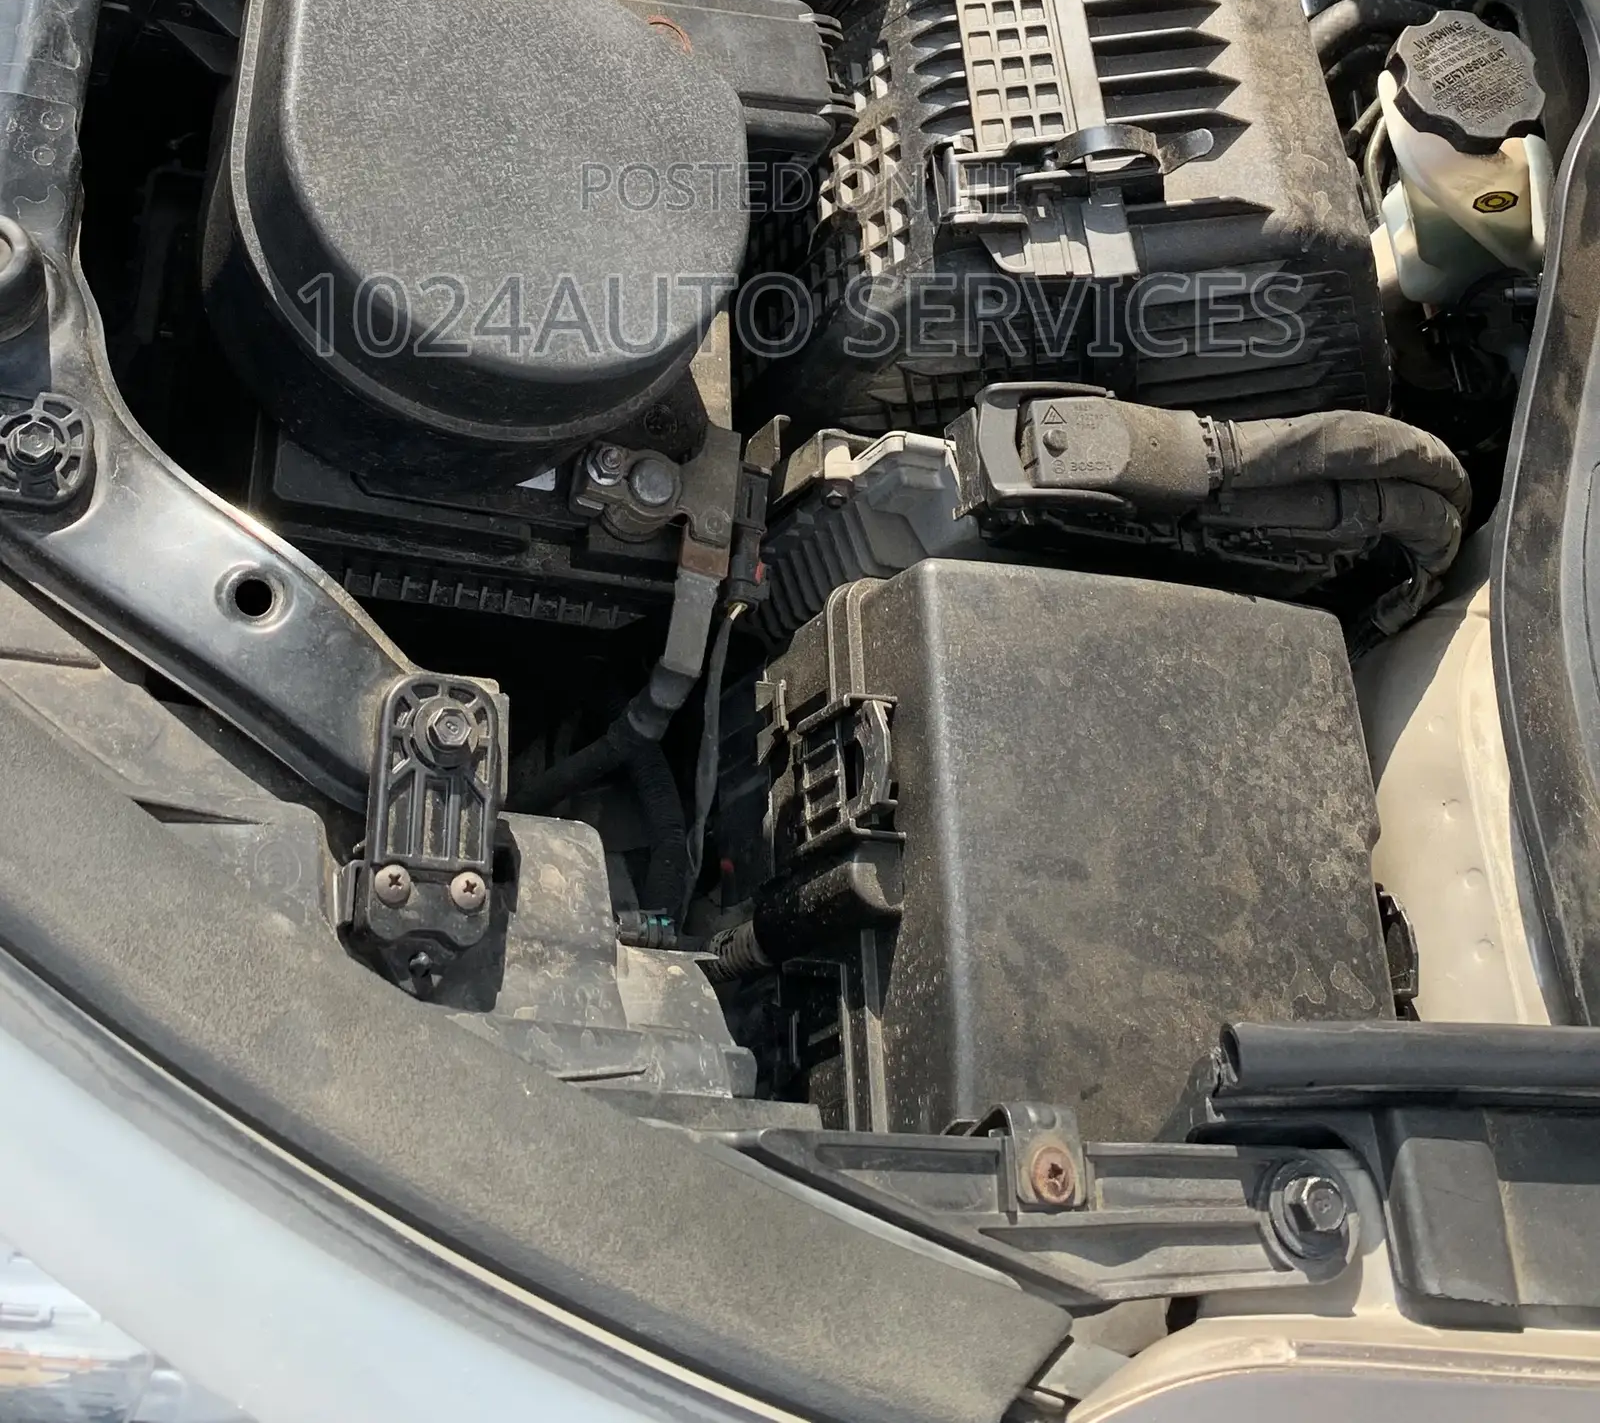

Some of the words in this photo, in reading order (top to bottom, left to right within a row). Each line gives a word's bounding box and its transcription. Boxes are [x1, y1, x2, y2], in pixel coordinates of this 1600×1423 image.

[1413, 20, 1464, 50] WARNING
[1432, 47, 1509, 92] AVERTISSEMENT
[1070, 461, 1113, 472] BOSCH
